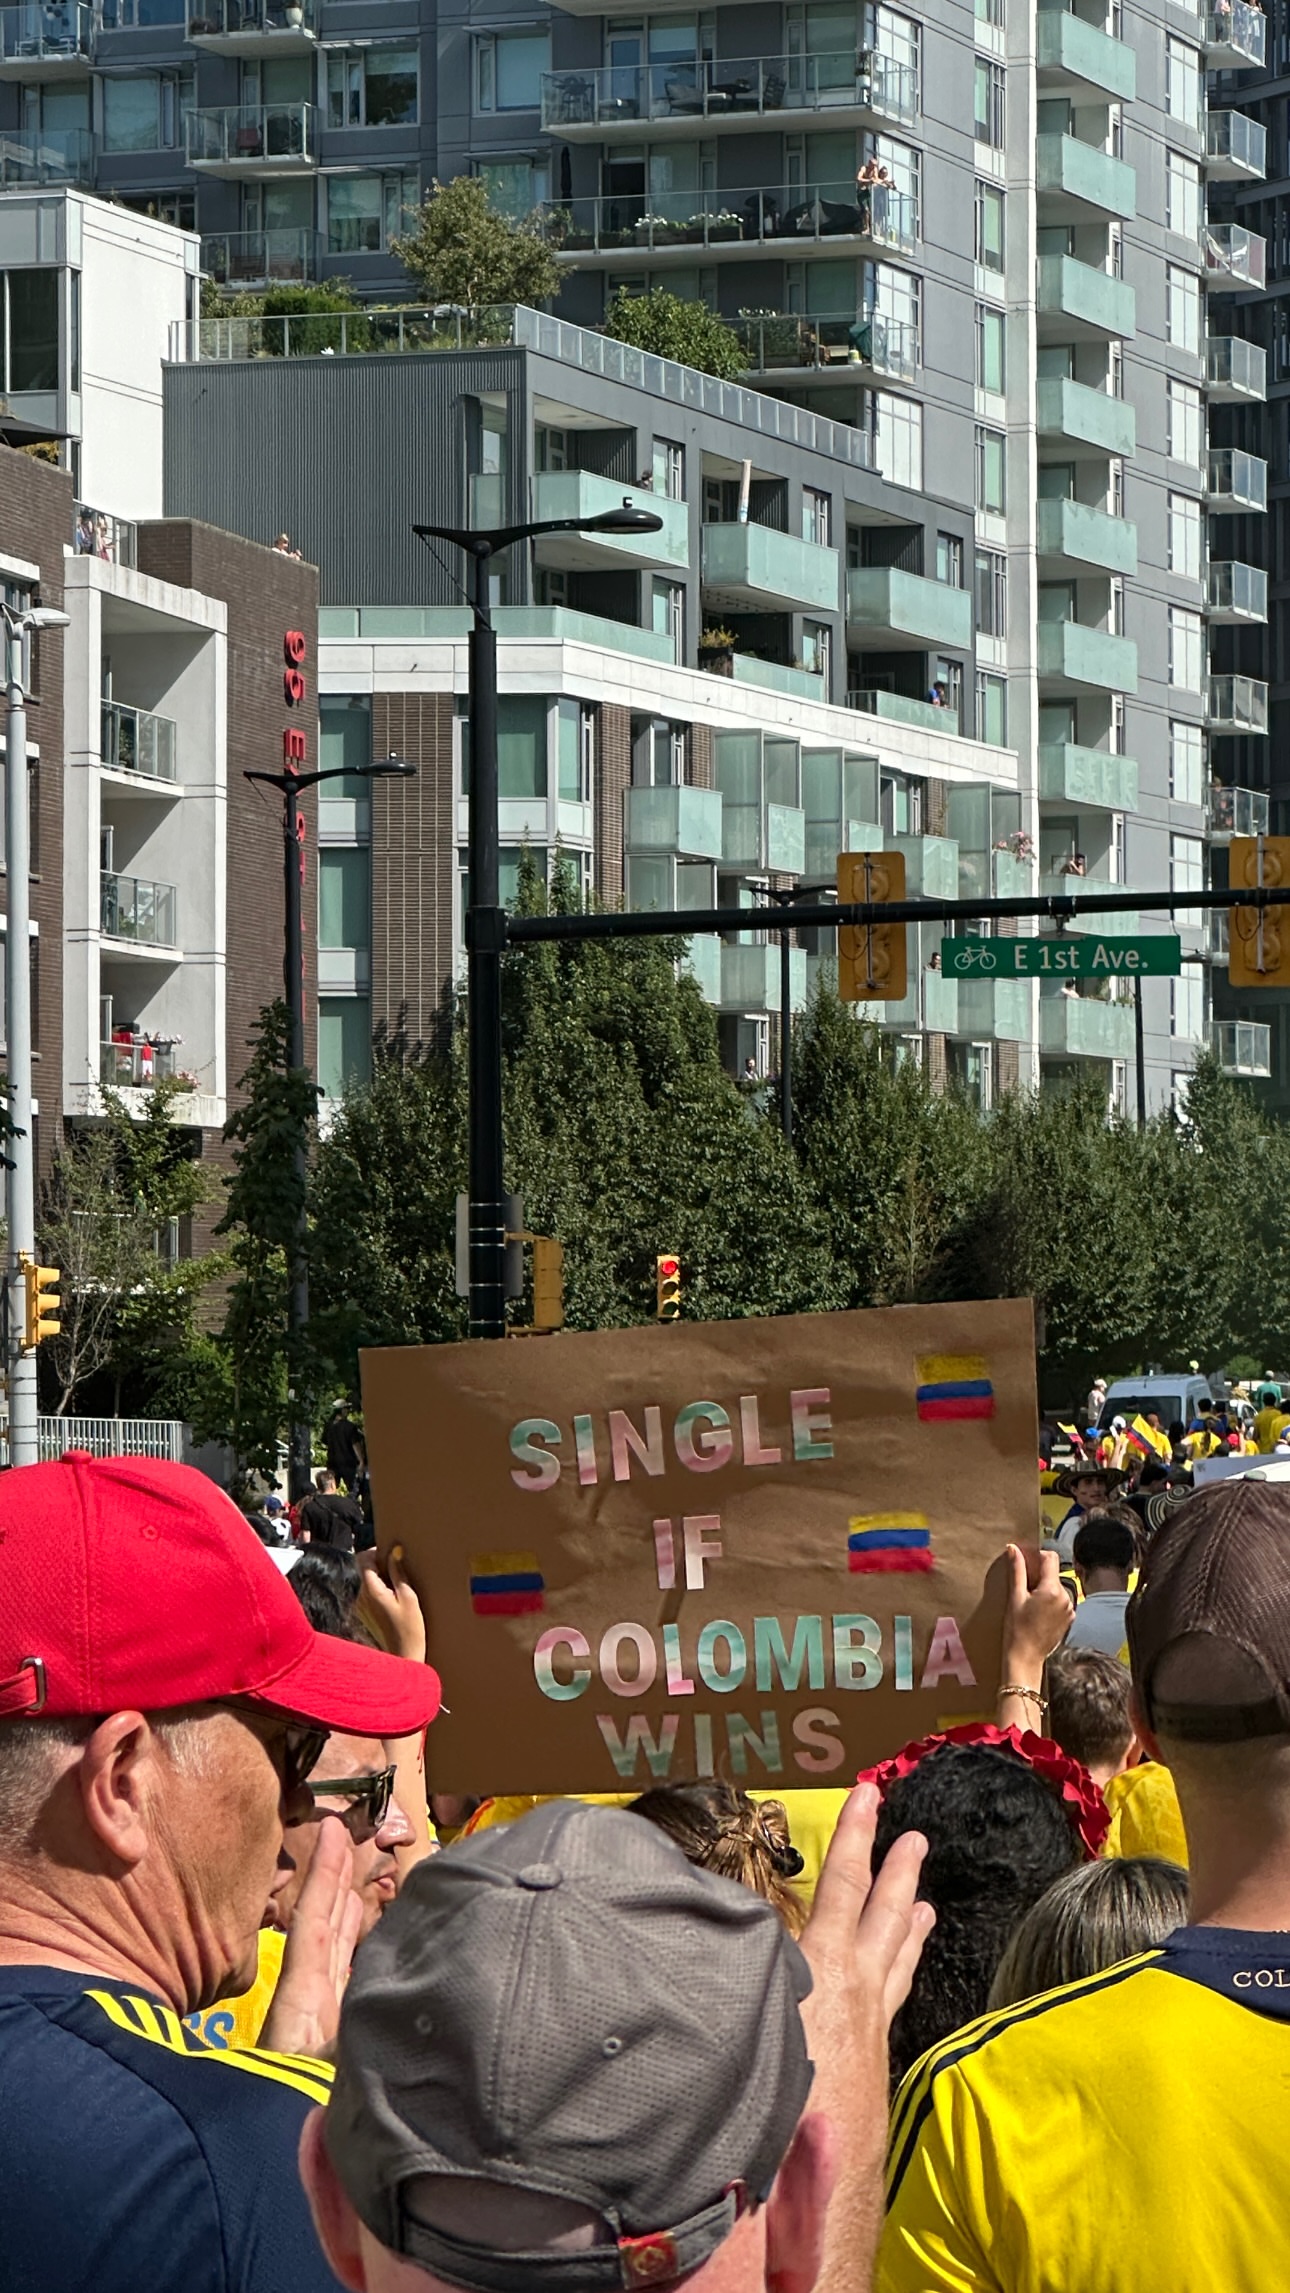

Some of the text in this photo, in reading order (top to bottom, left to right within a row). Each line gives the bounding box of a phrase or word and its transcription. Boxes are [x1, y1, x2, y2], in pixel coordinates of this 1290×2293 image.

[1014, 944, 1149, 969] E 1st Ave.
[508, 1387, 835, 1491] SINGLE
[652, 1515, 723, 1590] IF
[533, 1613, 977, 1700] COLOMBIA
[596, 1707, 845, 1777] WINS
